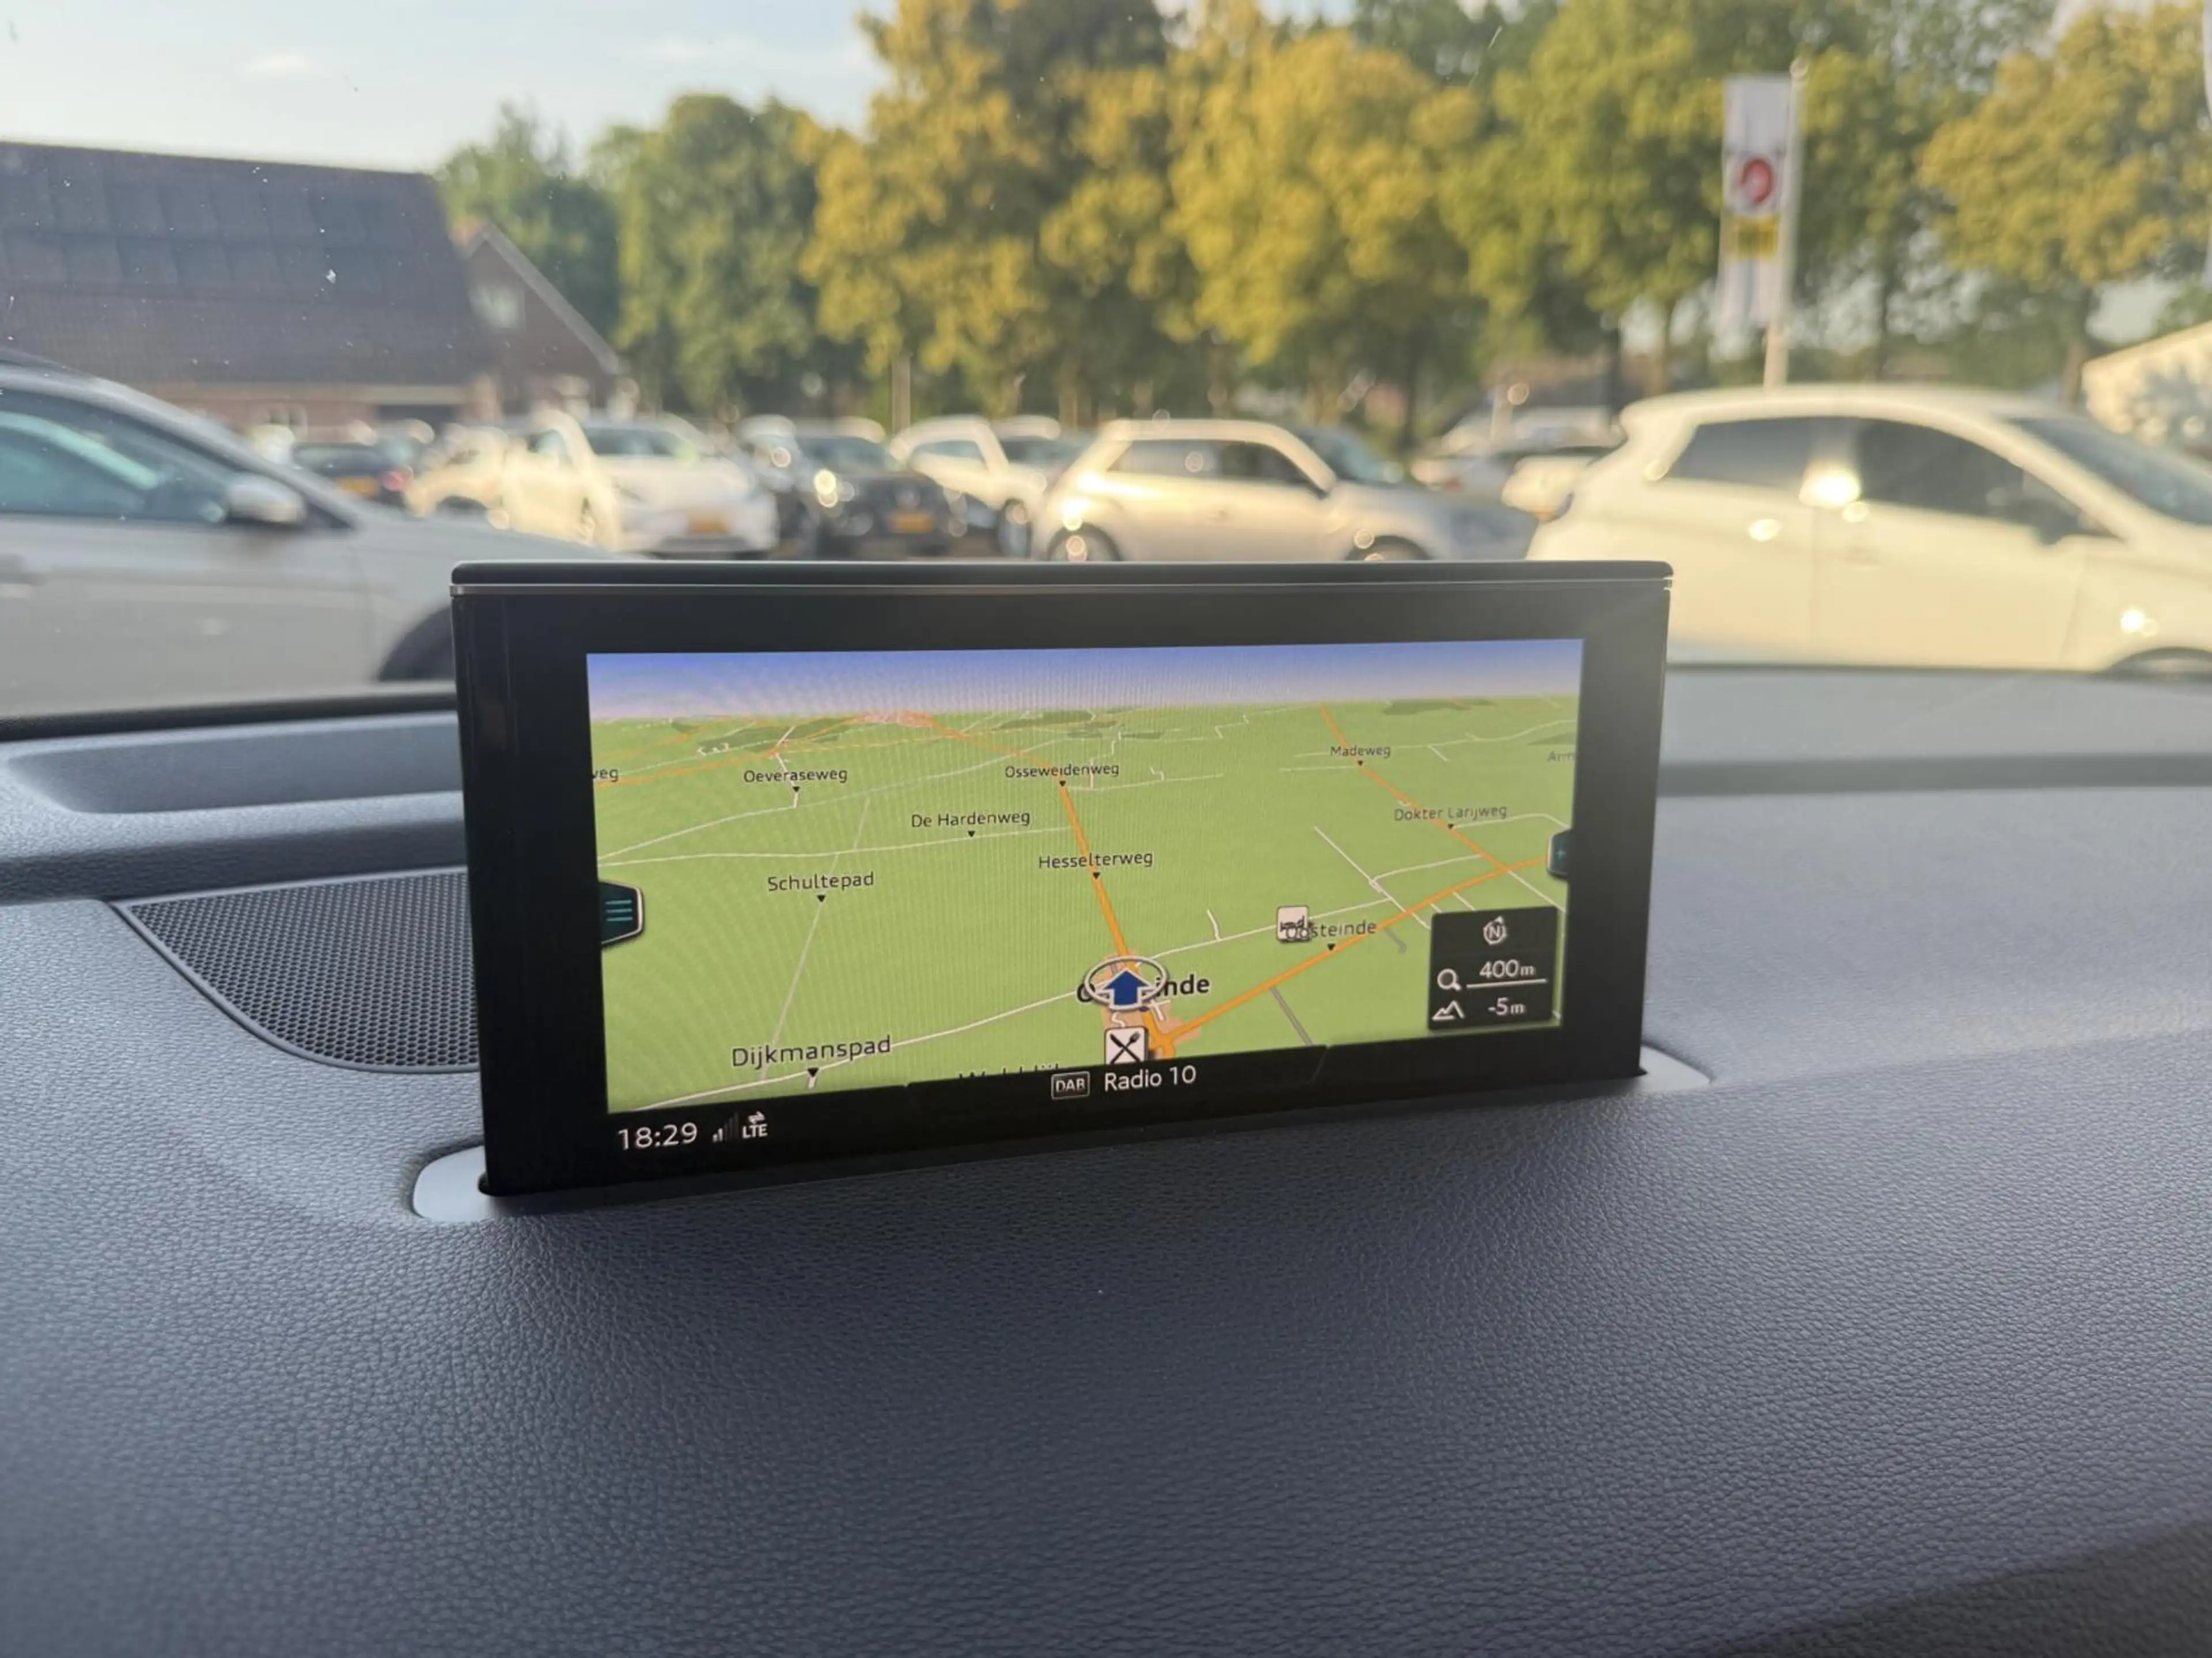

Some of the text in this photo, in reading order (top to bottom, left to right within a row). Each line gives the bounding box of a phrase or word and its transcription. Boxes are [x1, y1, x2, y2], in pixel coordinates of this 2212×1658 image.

[1330, 745, 1391, 759] Madeweg
[743, 767, 847, 784] Oeveraseweg
[1005, 763, 1119, 778] Osseweidenweg
[911, 810, 1031, 828] De Hardenweg
[1394, 807, 1443, 821] Dokter
[1039, 851, 1153, 869] Hesselterweg
[767, 871, 874, 893] Schultepad
[732, 1035, 891, 1070] Dijkmanspad
[1055, 1077, 1086, 1093] DAB
[1104, 1065, 1197, 1091] Radio 10
[618, 1122, 698, 1151] 18:29
[742, 1124, 768, 1139] LTE
